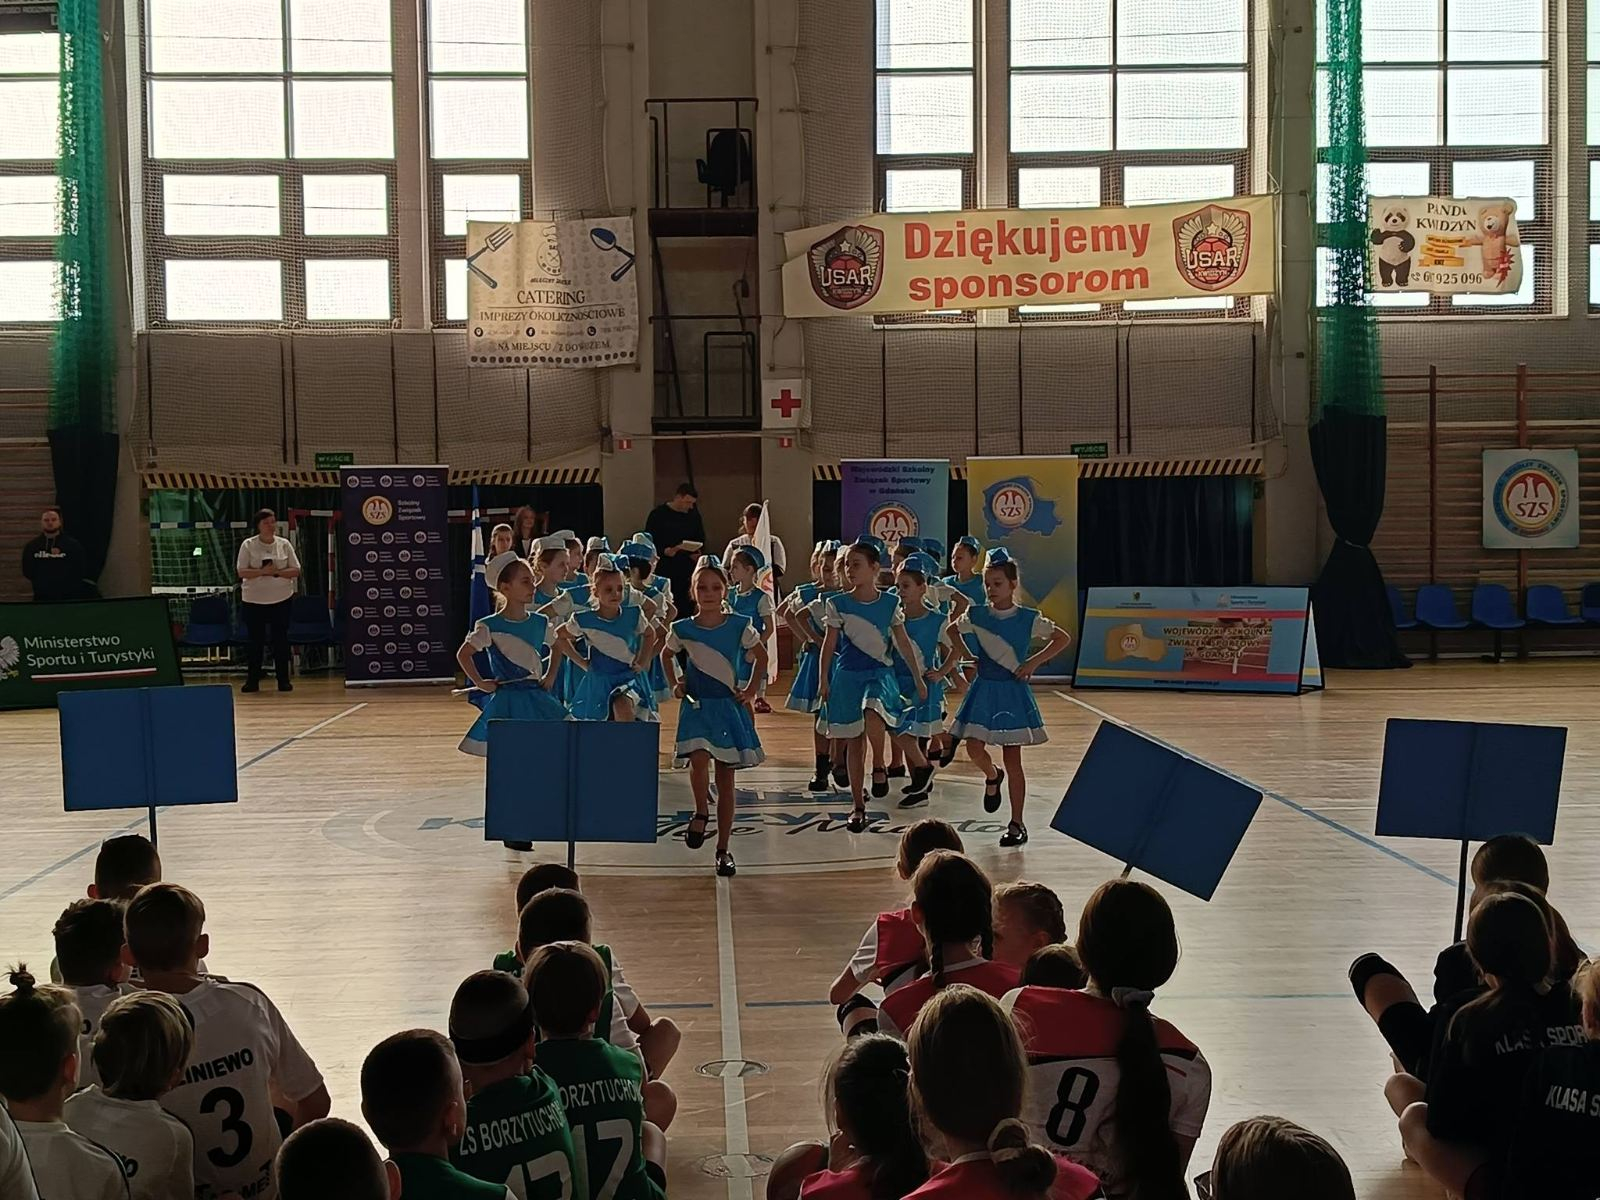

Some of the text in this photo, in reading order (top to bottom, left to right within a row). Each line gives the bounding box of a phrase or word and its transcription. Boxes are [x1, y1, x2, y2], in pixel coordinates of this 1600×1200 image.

[904, 218, 1151, 265] Dziękujemy
[1185, 246, 1238, 270] USAR
[820, 265, 873, 287] USAR
[908, 266, 1149, 308] sponsorom
[1436, 272, 1458, 284] 925
[1460, 272, 1482, 284] 096
[517, 290, 585, 305] CATERING
[480, 311, 528, 322] IMPREZY
[511, 342, 551, 352] MIEJSCU
[901, 465, 936, 475] Szkolny
[999, 506, 1022, 517] SZS
[1516, 501, 1549, 518] SZS
[23, 634, 120, 650] Ministerstwo
[26, 647, 155, 668] Sportu i Turystyki
[1546, 1024, 1588, 1048] SPOR
[559, 1078, 642, 1110] ORZYTUCHO
[1545, 1085, 1587, 1114] KLASA
[1045, 1066, 1100, 1147] 8
[199, 1086, 253, 1168] 3
[570, 1118, 634, 1200] 17
